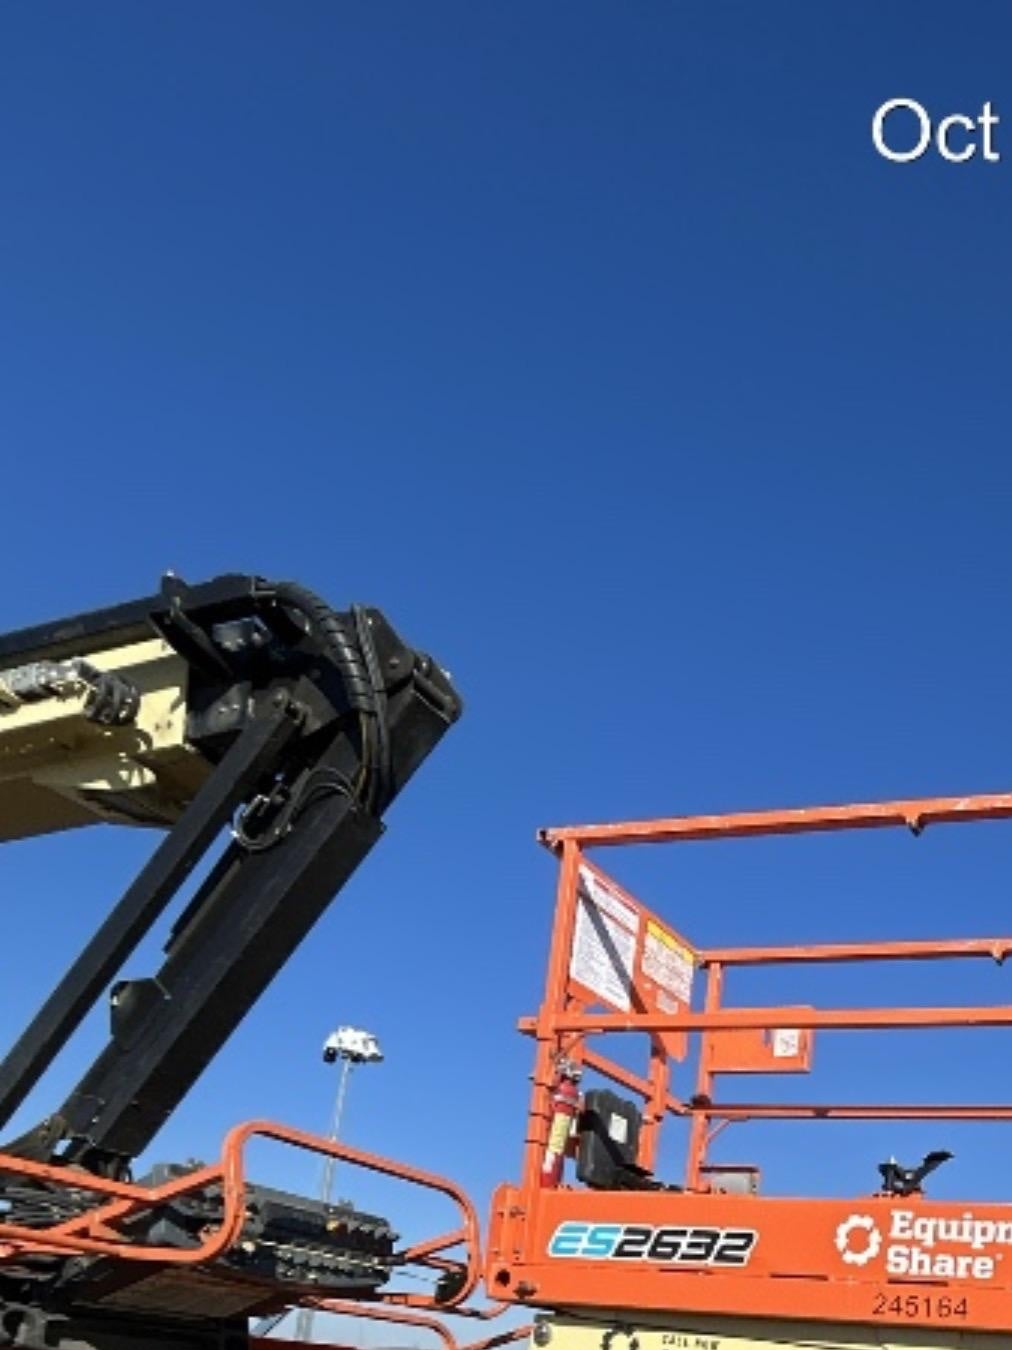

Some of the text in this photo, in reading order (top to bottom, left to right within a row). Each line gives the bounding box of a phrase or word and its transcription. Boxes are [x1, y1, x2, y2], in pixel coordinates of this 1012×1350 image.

[549, 1223, 756, 1266] ES2632
[885, 1246, 996, 1280] Share
[871, 1291, 969, 1320] 245164
